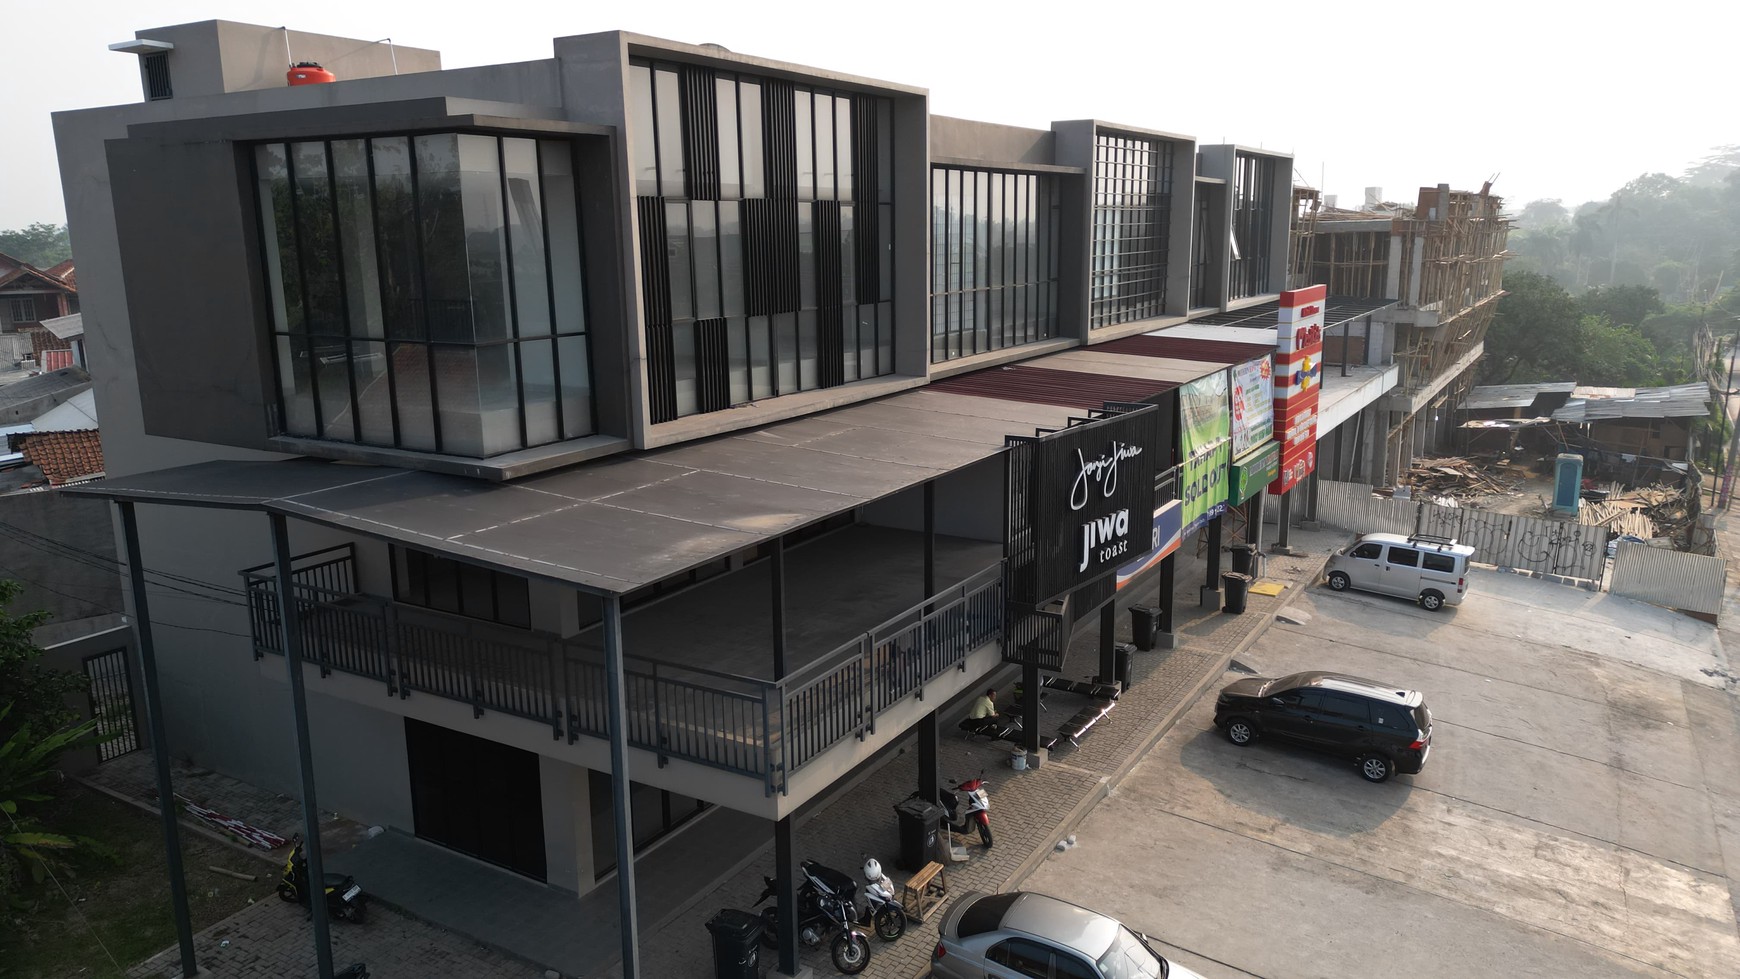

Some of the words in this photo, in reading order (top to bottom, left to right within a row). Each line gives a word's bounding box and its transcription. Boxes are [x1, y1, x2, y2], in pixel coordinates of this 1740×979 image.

[1070, 447, 1112, 510] Janji
[1104, 441, 1142, 497] Jiwa
[1184, 473, 1208, 506] SOLD
[1100, 540, 1128, 563] toast
